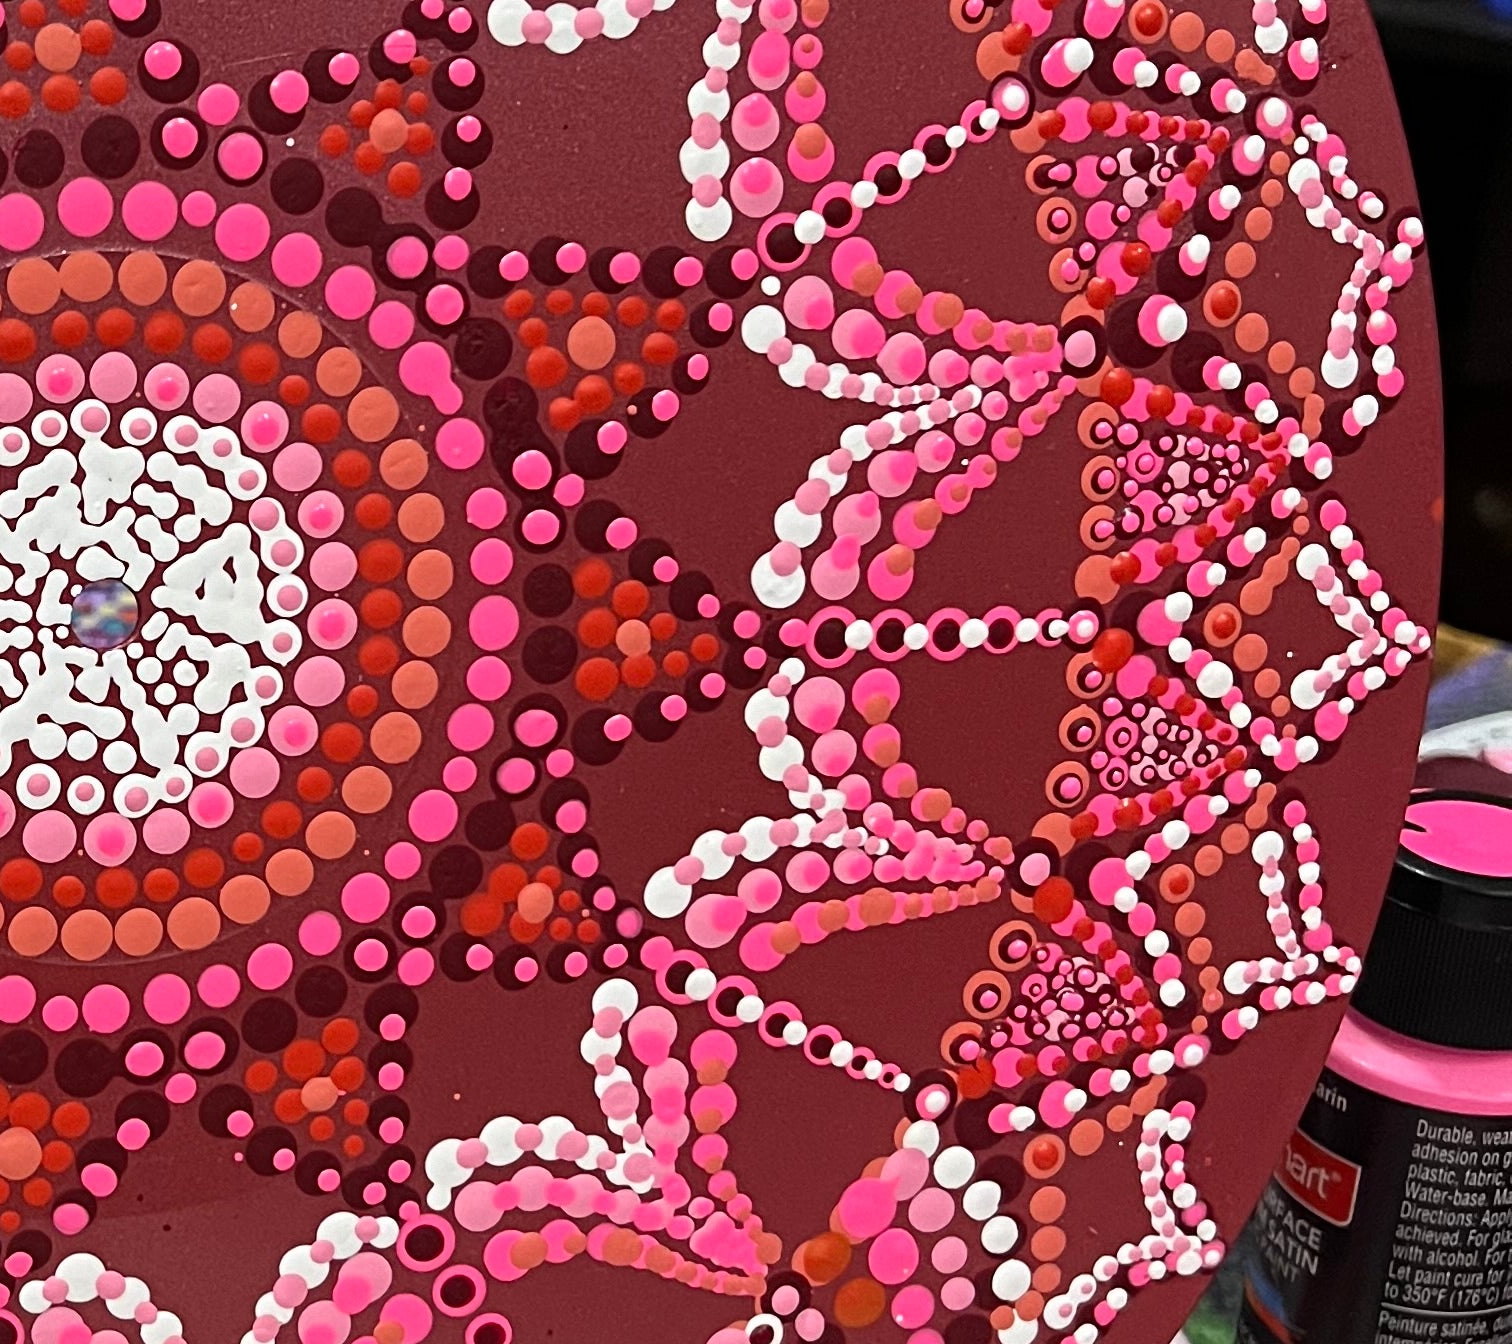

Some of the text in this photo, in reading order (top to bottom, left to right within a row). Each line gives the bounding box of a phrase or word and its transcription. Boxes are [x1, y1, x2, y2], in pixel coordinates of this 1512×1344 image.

[1411, 1142, 1479, 1166] adhesion
[1481, 1151, 1501, 1167] on
[1285, 1143, 1329, 1200] art
[1267, 1218, 1319, 1276] SATIN
[1467, 1229, 1491, 1247] For
[1392, 1243, 1424, 1263] with
[1484, 1246, 1507, 1266] For
[1388, 1260, 1506, 1288] Let paint cure for
[1384, 1282, 1399, 1299] to
[1378, 1310, 1438, 1337] Peinture
